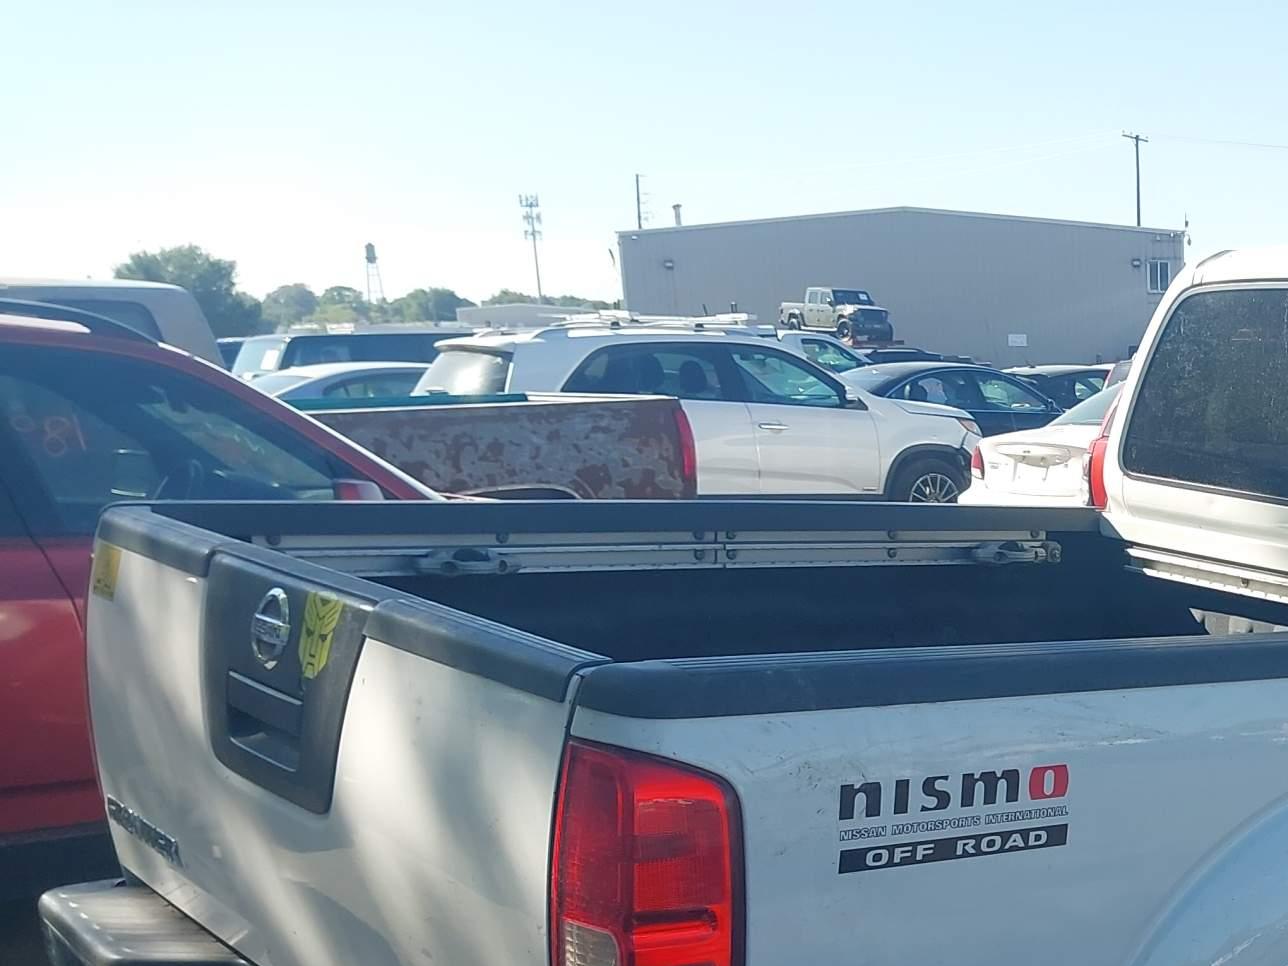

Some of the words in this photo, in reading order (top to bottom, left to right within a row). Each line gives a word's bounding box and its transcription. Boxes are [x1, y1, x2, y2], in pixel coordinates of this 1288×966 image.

[839, 826, 887, 842] NISSAN
[891, 815, 981, 835] MOTORSPORTS
[984, 805, 1069, 825] INTERNATIONAL
[865, 843, 935, 867] OFF
[955, 830, 1048, 856] ROAD
